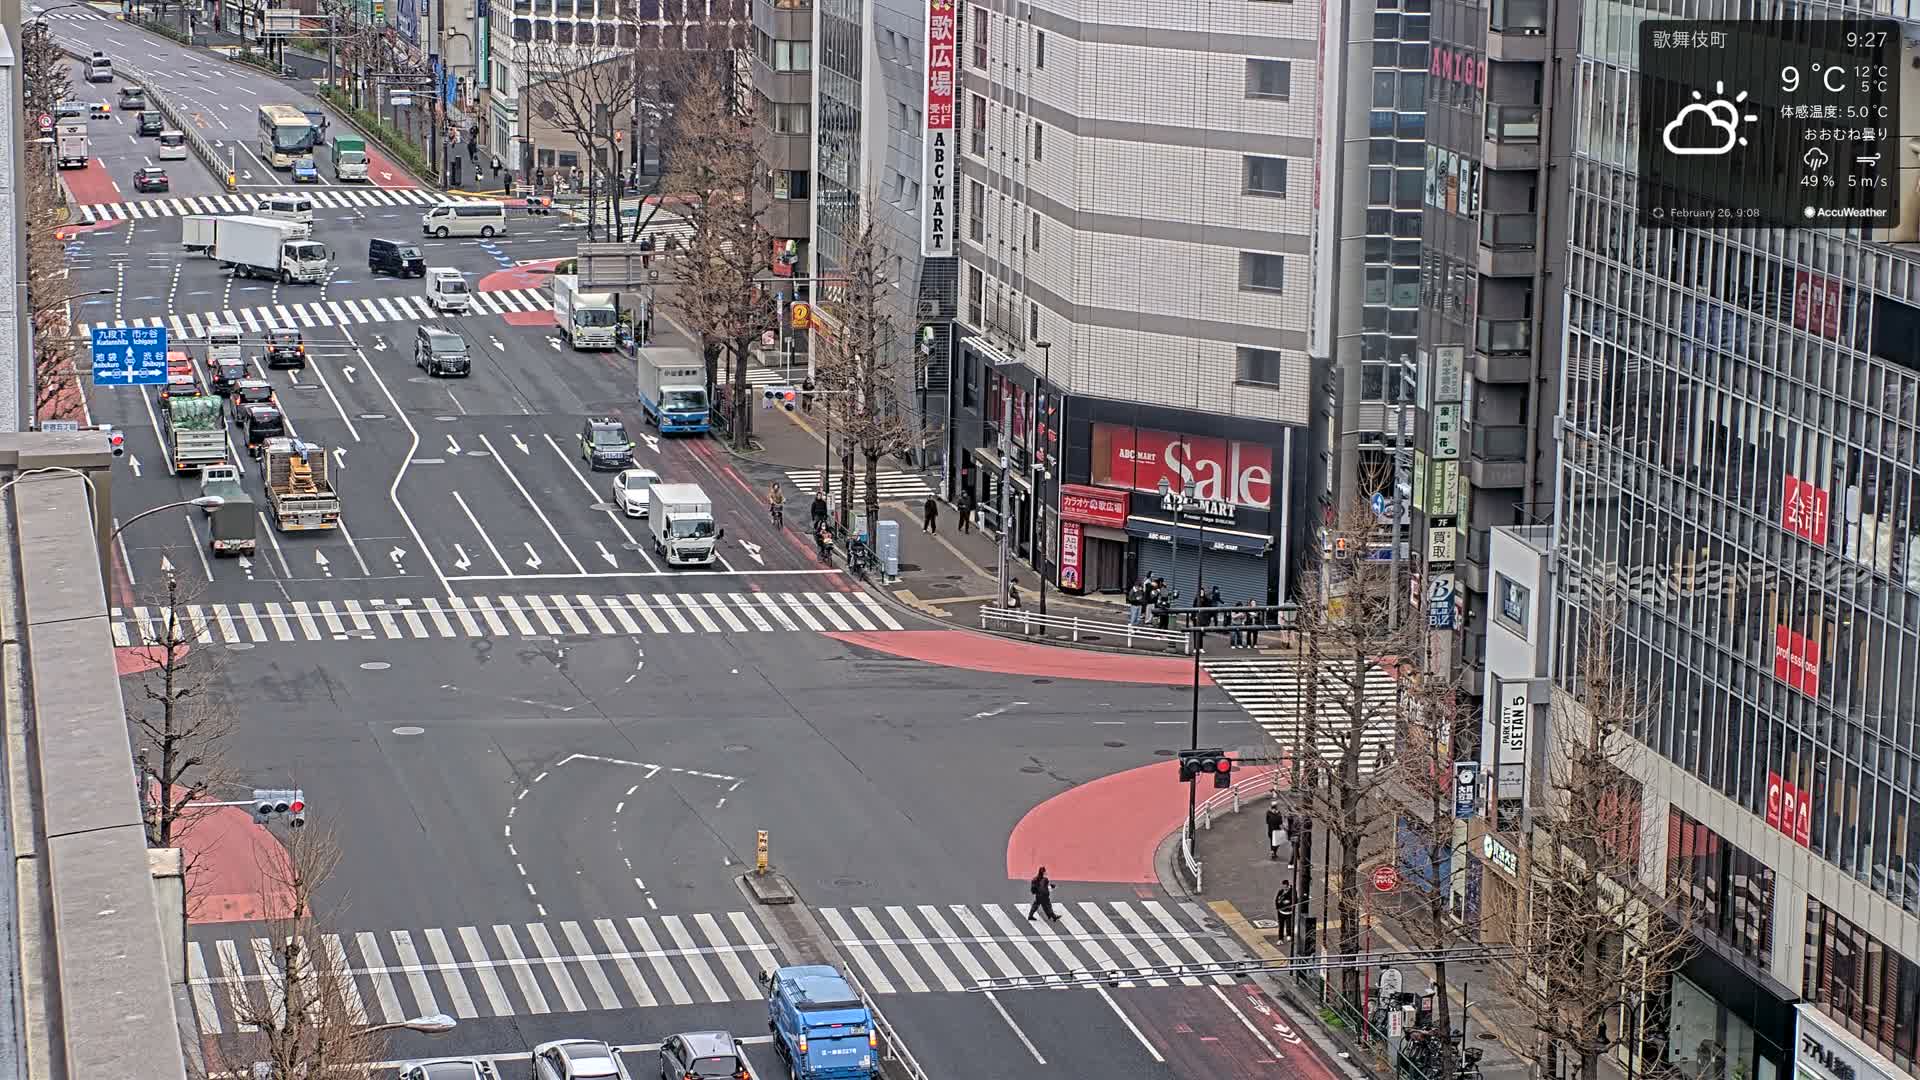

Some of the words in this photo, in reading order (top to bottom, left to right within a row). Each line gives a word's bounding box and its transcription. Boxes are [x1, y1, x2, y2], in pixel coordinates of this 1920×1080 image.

[930, 15, 953, 96] 歌広場
[1431, 47, 1486, 89] AMIGO
[929, 104, 951, 114] 受付
[929, 115, 951, 125] 5F
[98, 330, 126, 339] 九段下
[95, 352, 117, 362] 池袋
[143, 351, 164, 360] 渋谷
[1164, 440, 1272, 506] Sale
[1064, 495, 1089, 508] カラオケ
[1098, 500, 1122, 513] 歌広場
[1788, 486, 1824, 535] 会計
[1438, 518, 1449, 526] 7F
[1433, 531, 1446, 558] 買取
[1512, 695, 1525, 706] 5
[1503, 706, 1511, 724] CITY
[1502, 726, 1510, 744] PARK
[1511, 710, 1524, 751] ISETAN
[1769, 783, 1809, 833] CPA
